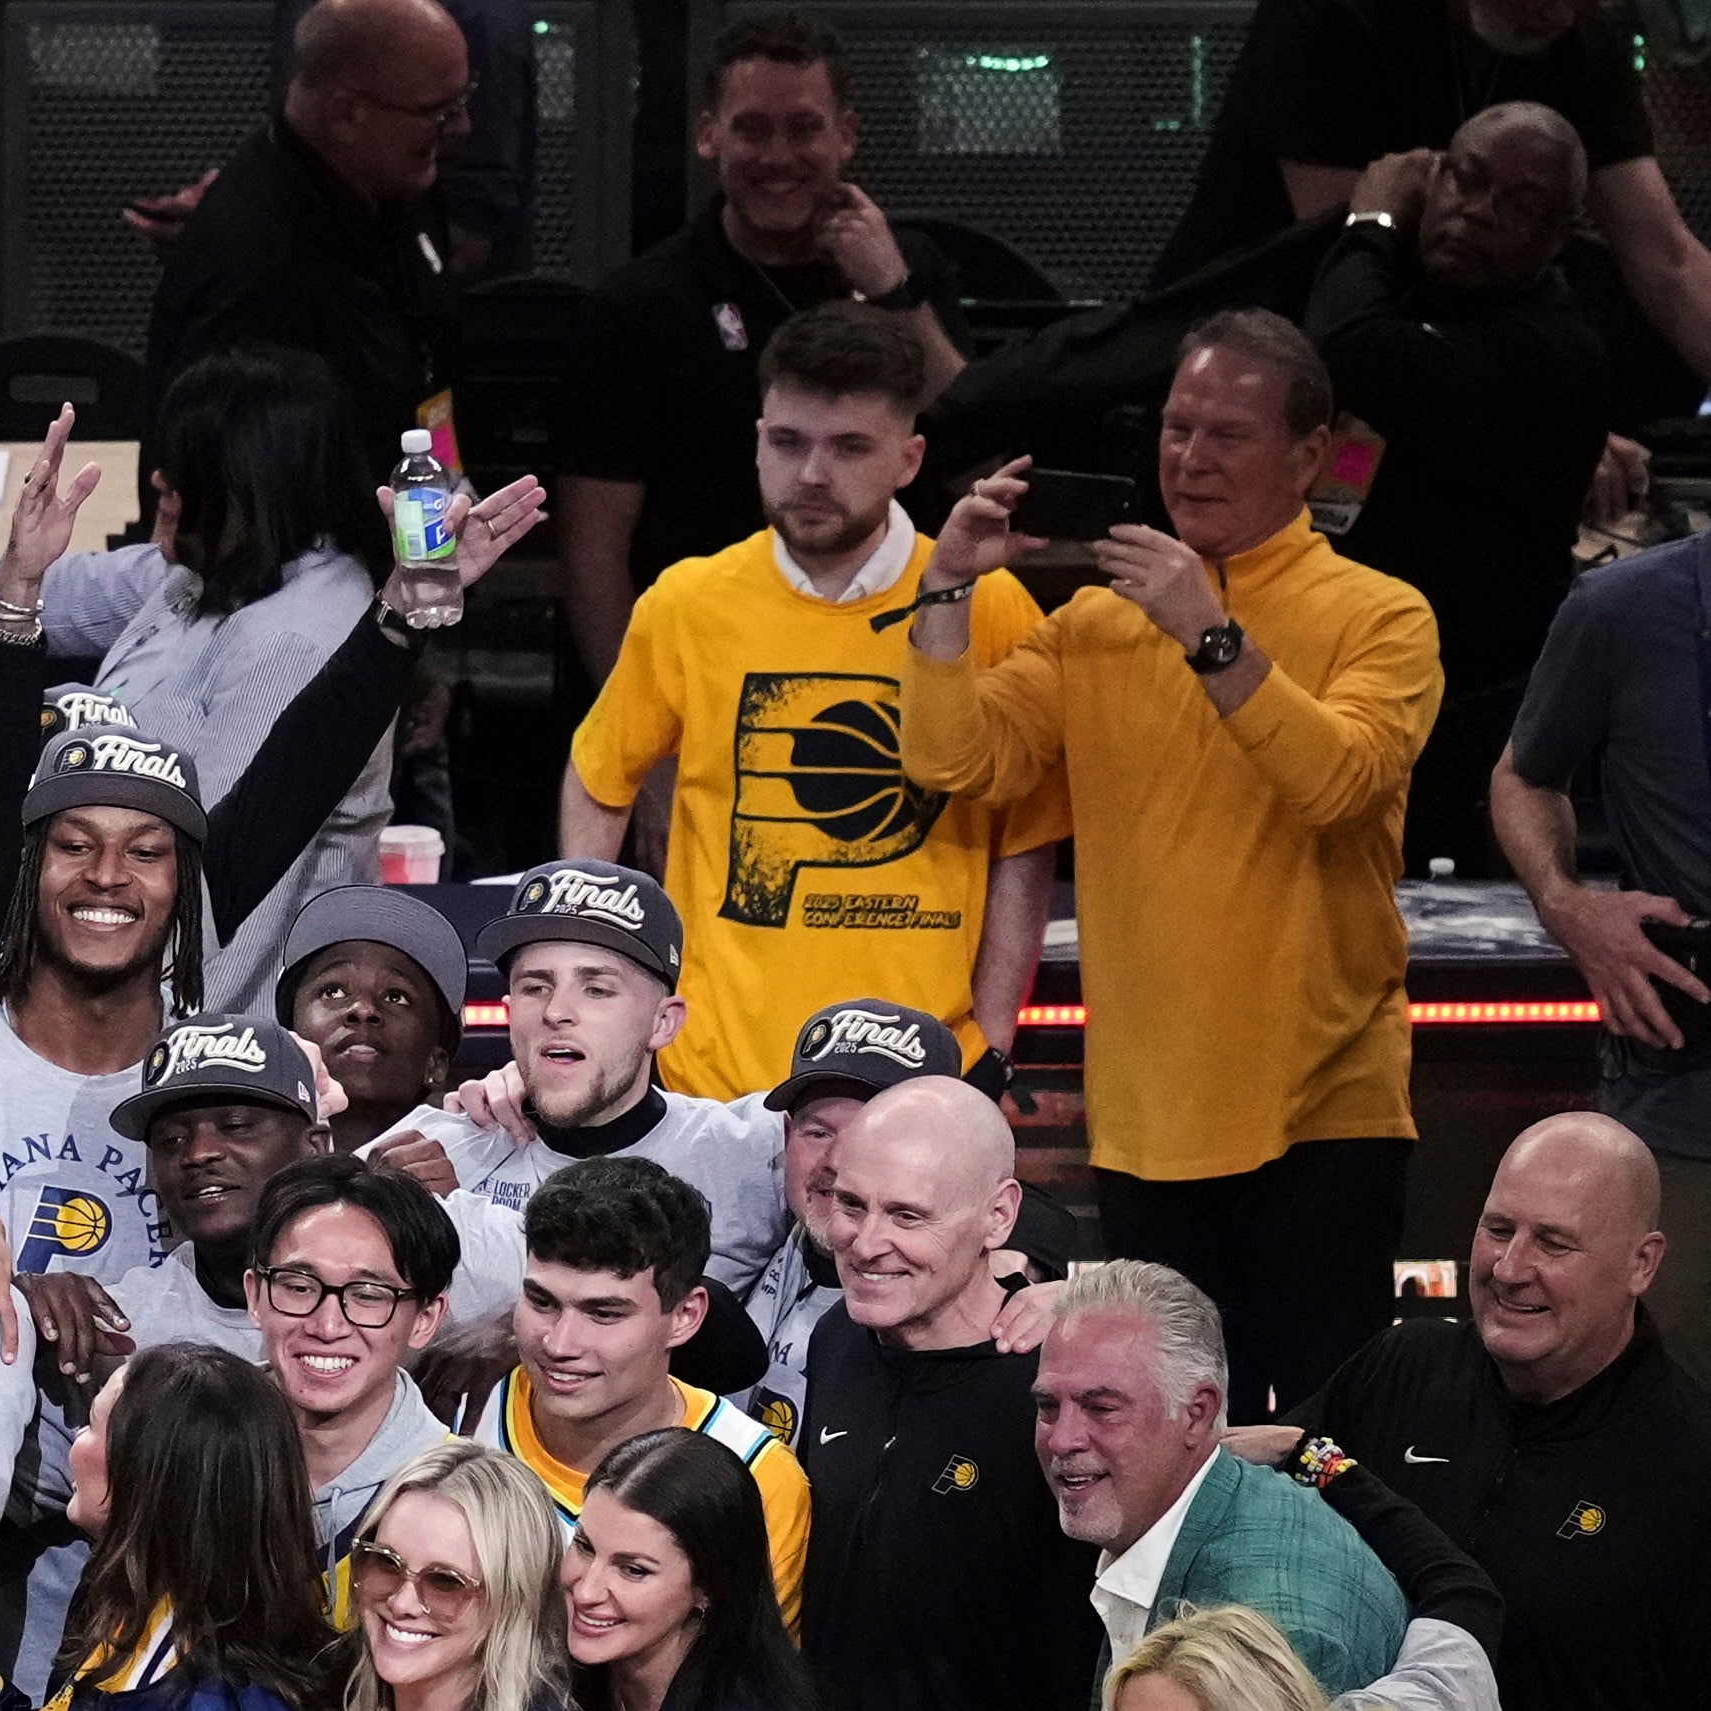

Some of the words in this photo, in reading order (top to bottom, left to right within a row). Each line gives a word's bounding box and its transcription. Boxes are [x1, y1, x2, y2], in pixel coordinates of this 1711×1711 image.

[86, 735, 185, 788] Finals
[539, 869, 644, 928] Finals
[554, 902, 577, 916] 2025
[157, 1021, 266, 1086] Finals
[818, 1008, 925, 1068] Finals
[834, 1041, 857, 1054] 2025
[174, 1058, 197, 1074] 2025
[495, 1181, 529, 1200] LOCKER
